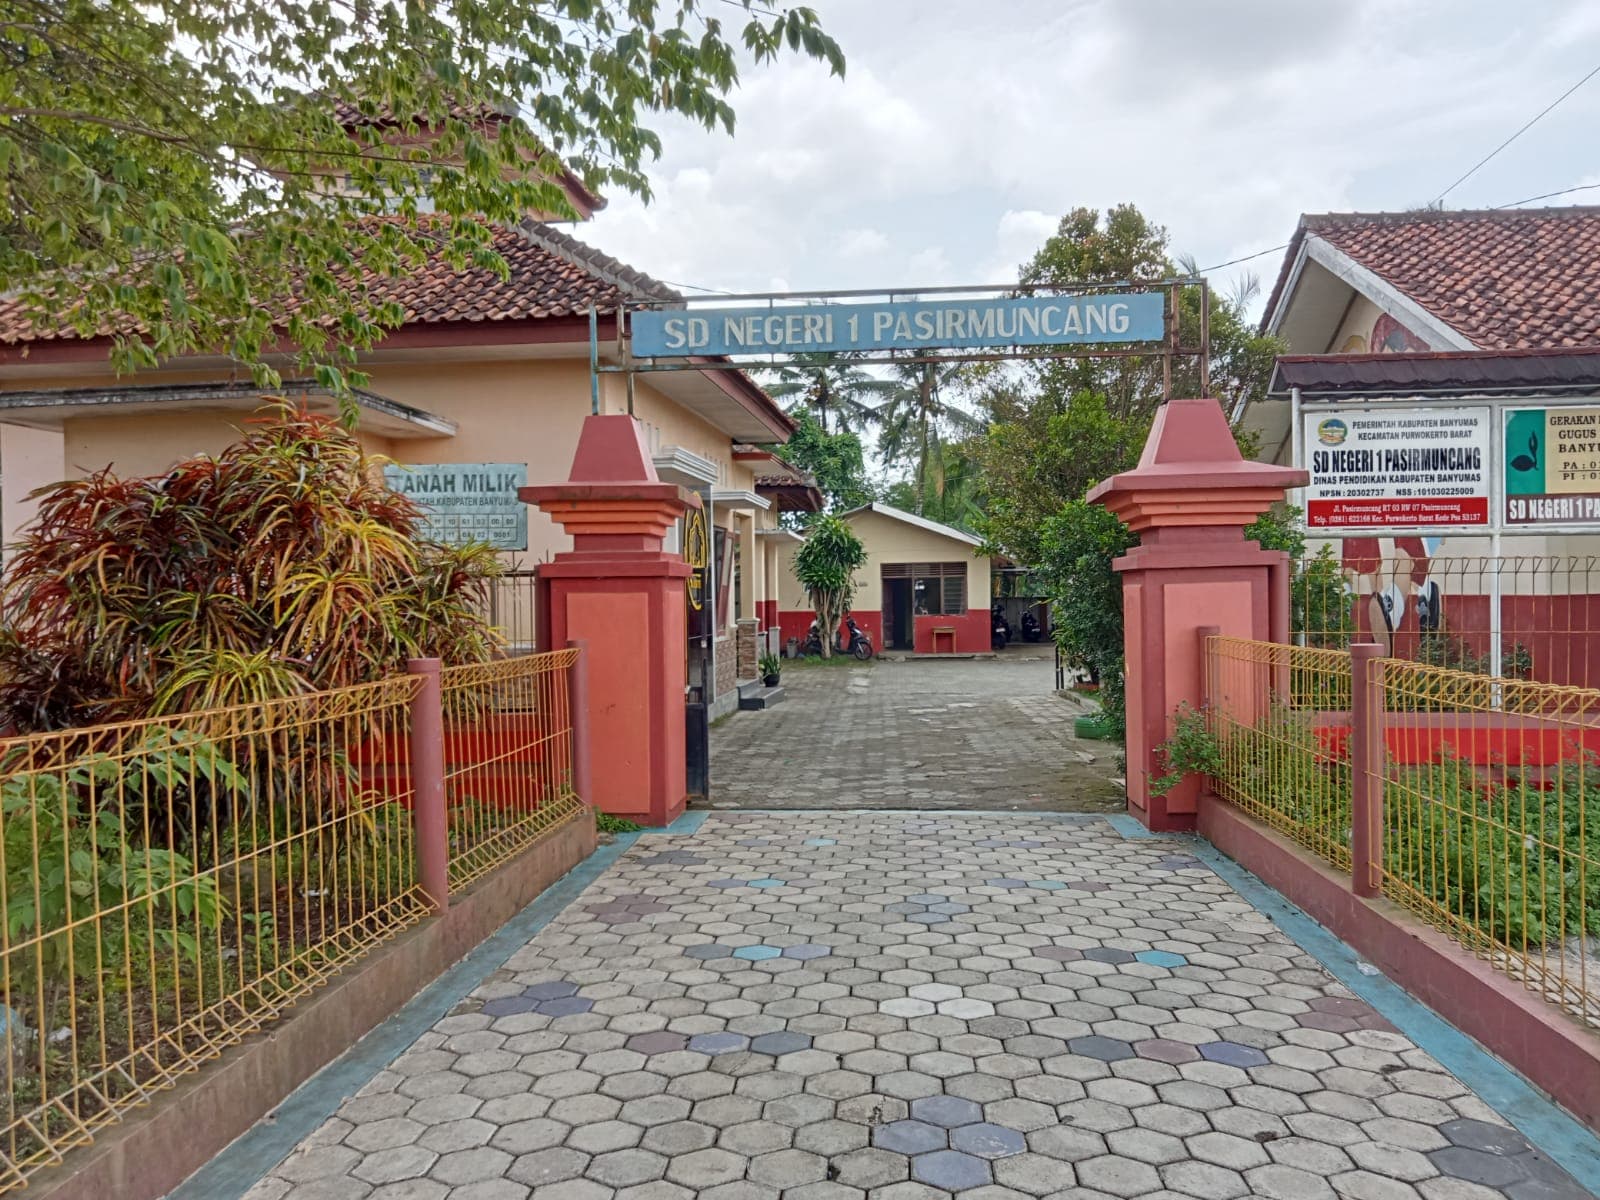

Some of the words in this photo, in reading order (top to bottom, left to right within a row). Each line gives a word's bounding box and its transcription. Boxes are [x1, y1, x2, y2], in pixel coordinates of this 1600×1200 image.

[664, 318, 710, 349] SD
[723, 314, 834, 347] NEGERI
[846, 317, 860, 342] 1
[873, 302, 1131, 342] PASIRMUNCANG
[1352, 420, 1396, 430] PEMERINTAH
[1398, 419, 1438, 428] KABUPATEN
[1440, 418, 1478, 427] BANYUMAS
[1550, 416, 1596, 426] GERAKAN
[1358, 432, 1399, 440] KECAMATAN
[1401, 431, 1448, 440] PURWOKERTO
[1450, 430, 1472, 438] BARAT
[1558, 430, 1596, 439] GUGUS
[1313, 450, 1329, 474] SD
[1332, 449, 1374, 473] NEGERI
[1376, 450, 1382, 472] 1
[1385, 447, 1481, 472] PASIRMUNCANG
[1563, 462, 1578, 470] PA
[463, 474, 517, 492] MILIK
[1314, 476, 1336, 485] DINAS
[1339, 475, 1387, 484] PENDIDIKAN
[1389, 474, 1434, 484] KABUPATEN
[1438, 474, 1481, 483] BANYUMAS
[1509, 498, 1526, 520] SD
[1529, 498, 1574, 519] NEGERI
[1576, 498, 1582, 518] 1
